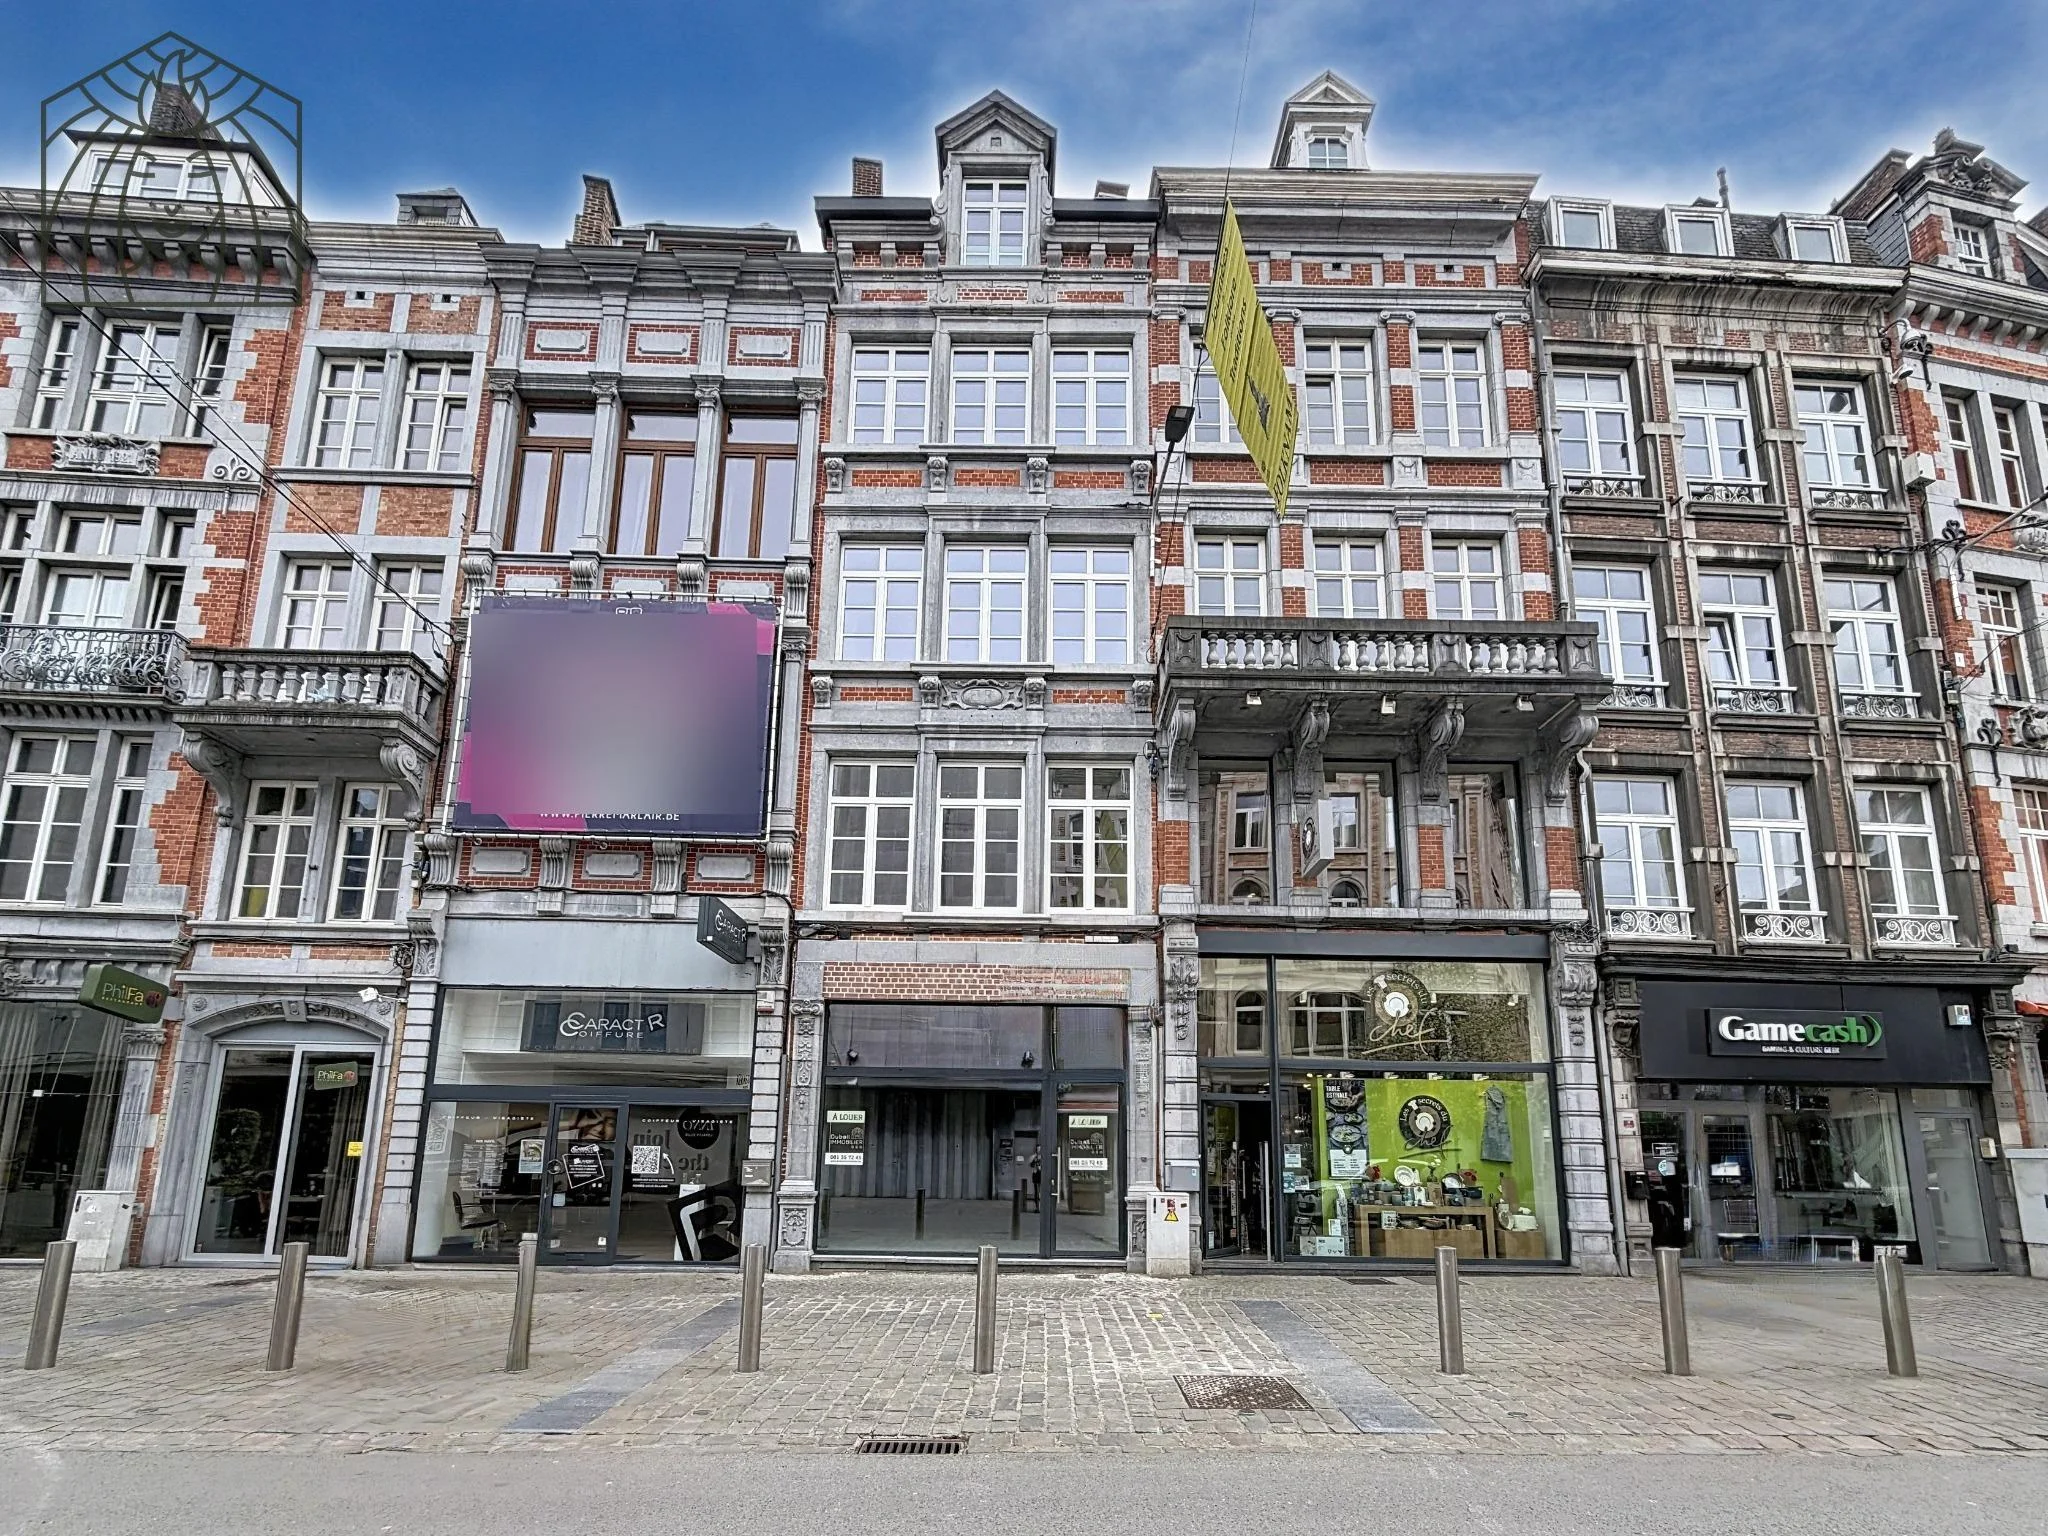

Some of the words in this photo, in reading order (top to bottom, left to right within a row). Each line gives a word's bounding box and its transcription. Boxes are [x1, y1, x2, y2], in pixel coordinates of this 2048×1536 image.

[1386, 972, 1420, 990] secrets
[103, 982, 144, 1003] PhilFa
[559, 1020, 645, 1039] COIFFURE
[568, 1011, 645, 1031] CARACT
[646, 1013, 666, 1032] R
[1369, 1007, 1438, 1056] chef
[317, 1070, 344, 1080] PhilFa
[839, 1113, 863, 1121] LOUER
[1400, 1108, 1409, 1121] Les
[1417, 1098, 1442, 1111] secrets
[1440, 1110, 1448, 1122] du
